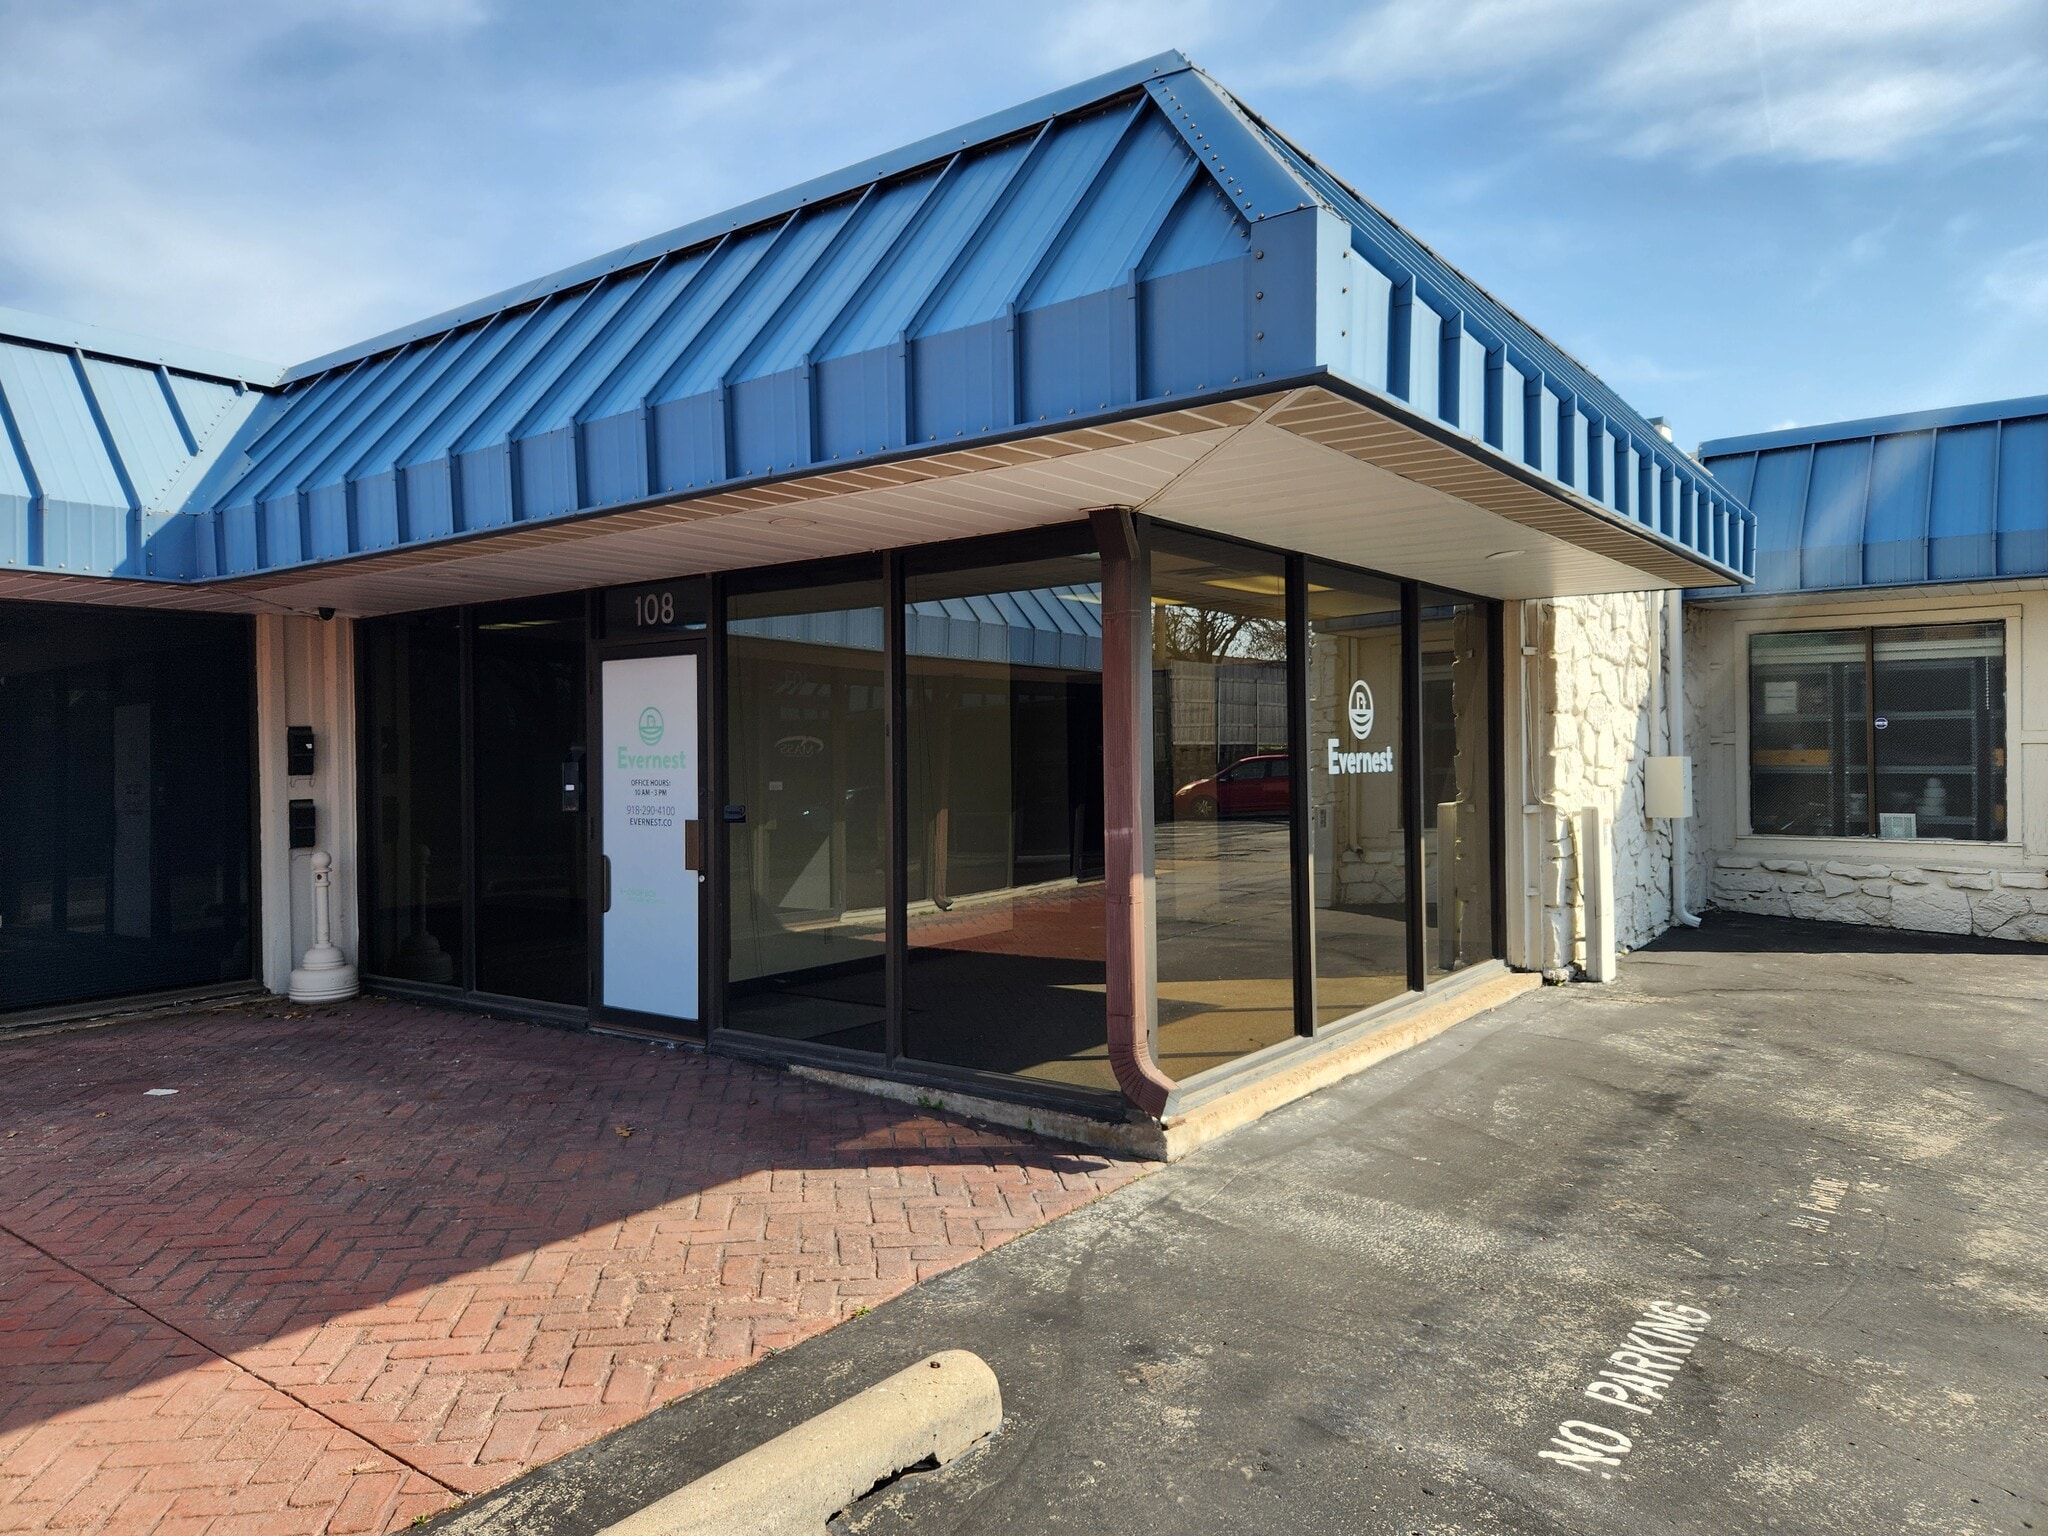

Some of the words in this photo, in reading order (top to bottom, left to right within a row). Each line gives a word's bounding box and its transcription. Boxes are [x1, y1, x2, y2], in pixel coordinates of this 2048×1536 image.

[635, 592, 674, 626] 108
[617, 746, 686, 769] Evernest
[1328, 739, 1393, 775] Evernest
[631, 779, 649, 787] OFFICE
[650, 779, 671, 787] HOURS:
[626, 805, 676, 816] 918-290-4100
[629, 817, 673, 827] EVERNEST.CO
[1538, 1420, 1632, 1480] NO
[1585, 1301, 1711, 1415] PARKING
